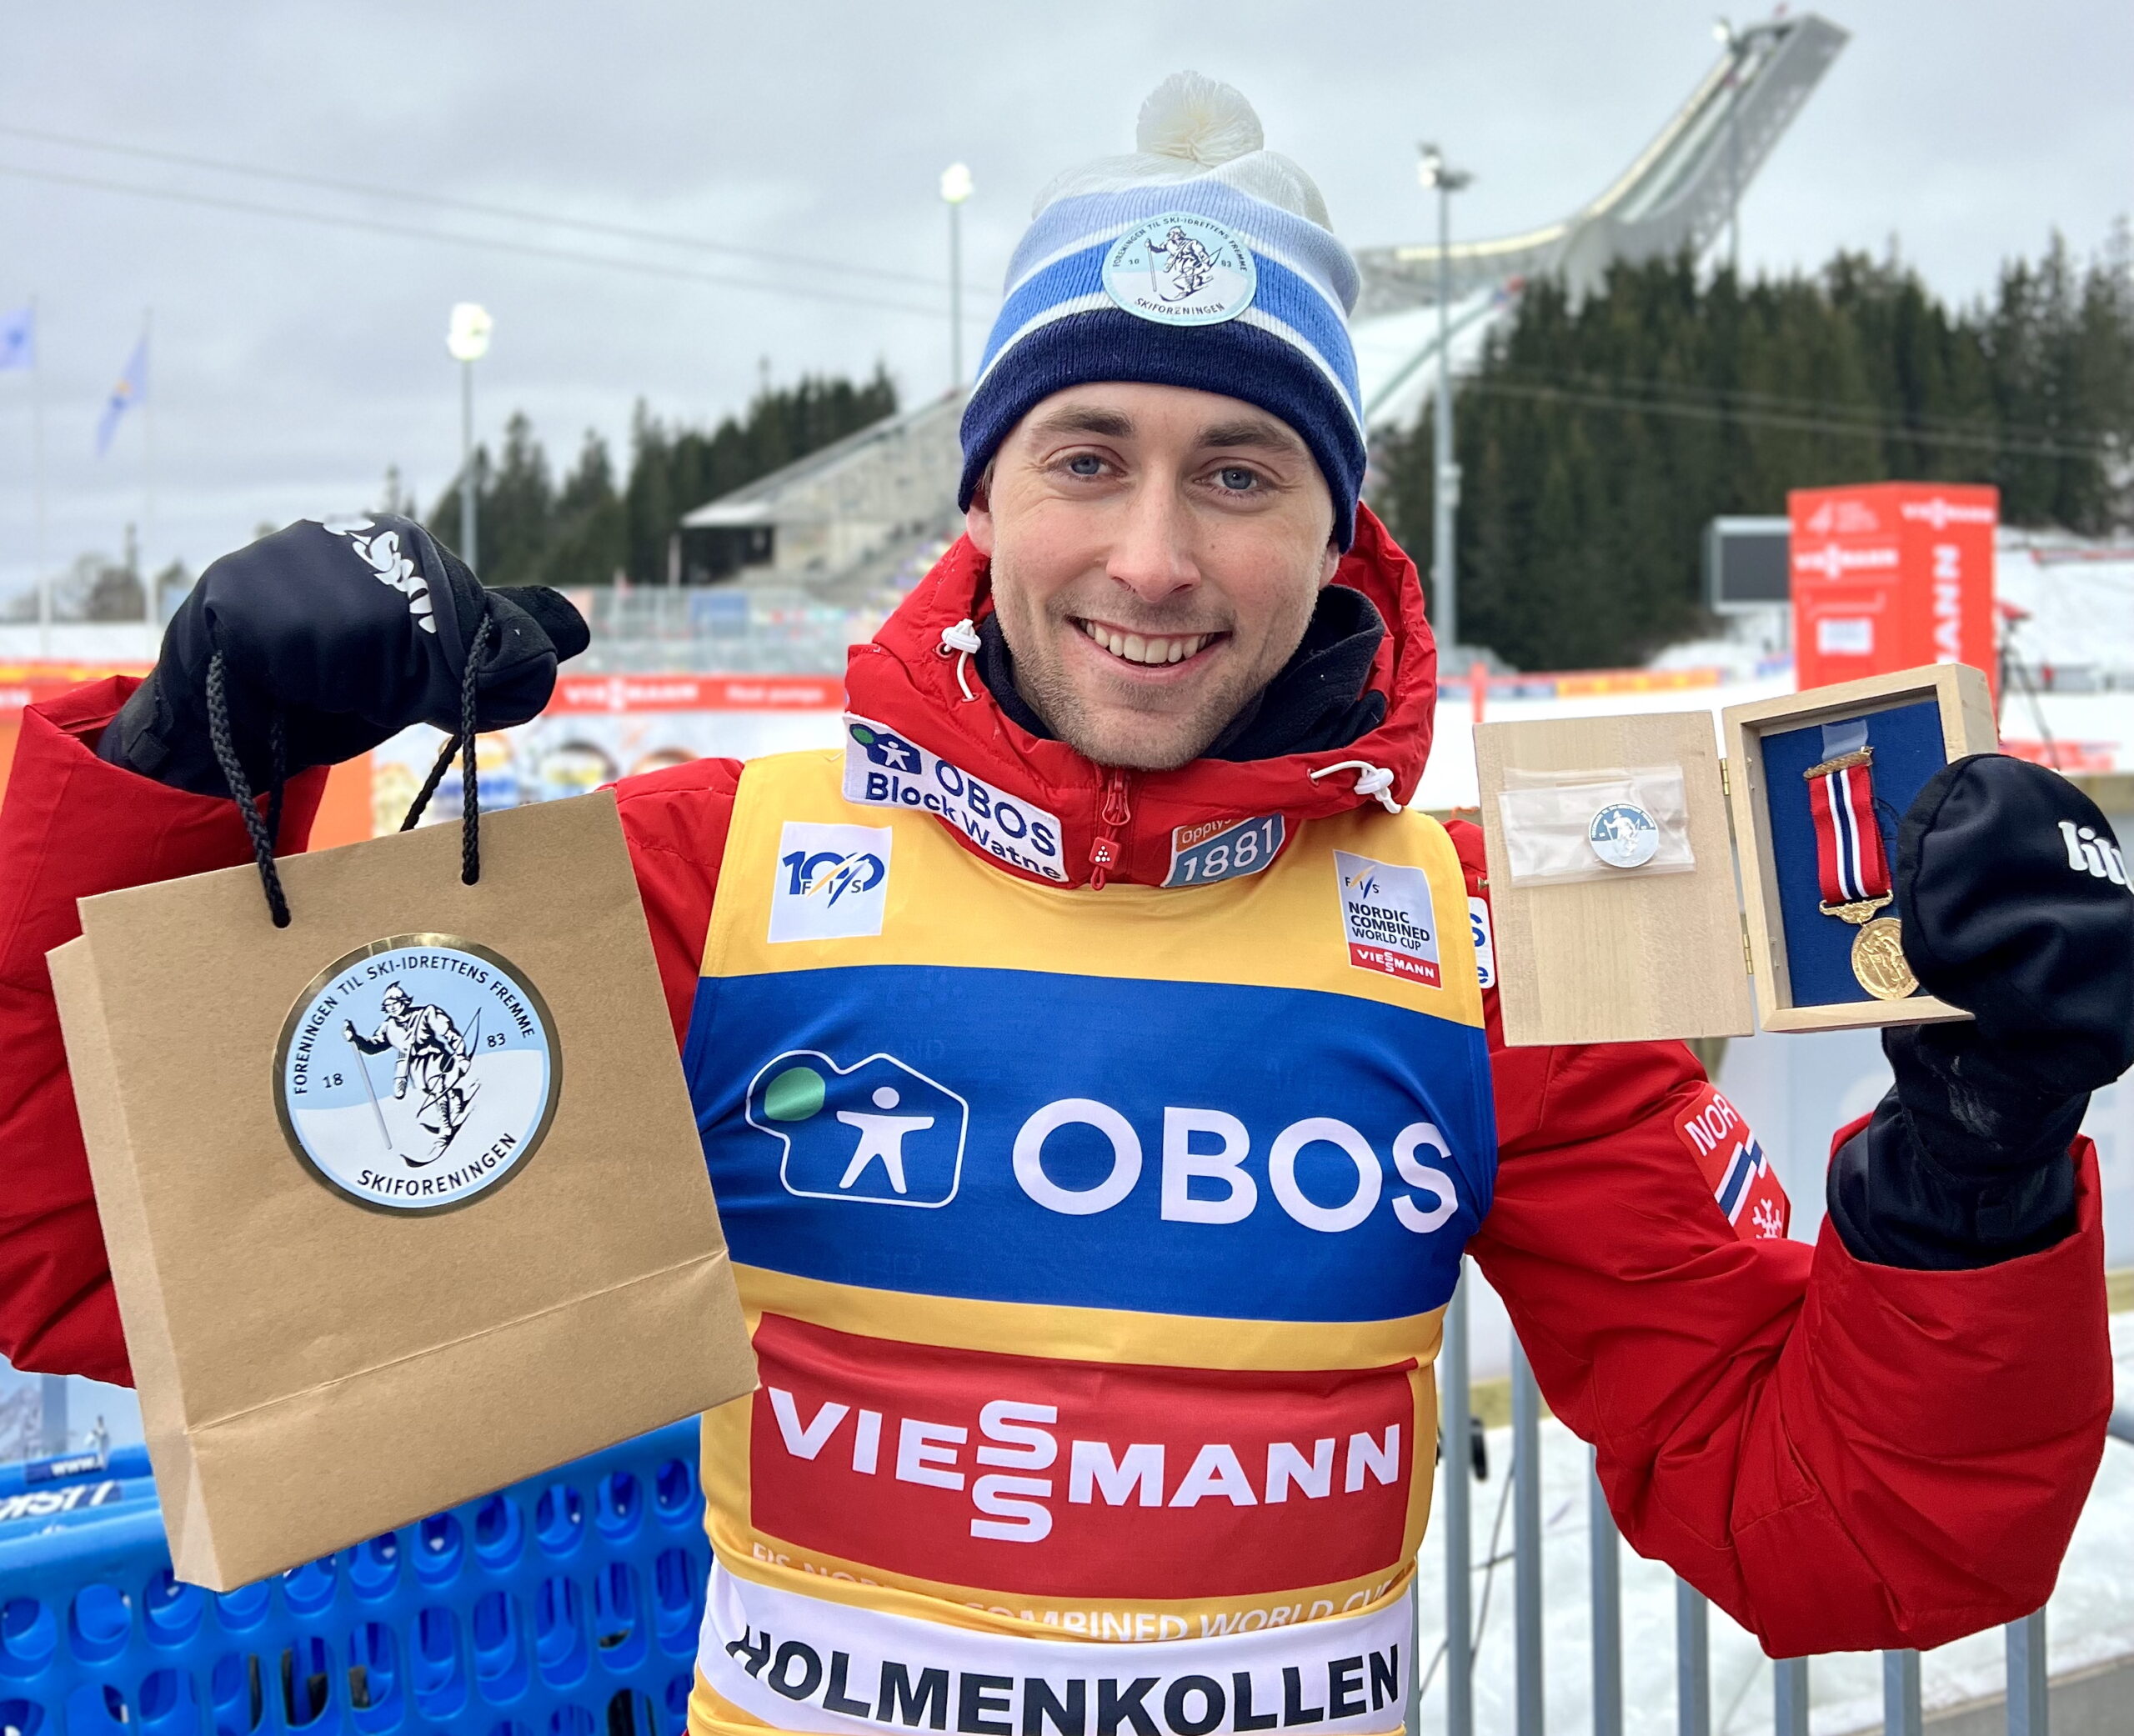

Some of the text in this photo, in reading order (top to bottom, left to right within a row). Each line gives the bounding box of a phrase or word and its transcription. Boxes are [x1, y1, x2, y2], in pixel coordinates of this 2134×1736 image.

[1147, 221, 1161, 231] TIL
[1163, 217, 1230, 239] SKI-IDRETTENS
[1229, 239, 1248, 272] FREMME
[1135, 298, 1225, 315] SKIFORENINGEN
[865, 772, 1062, 879] Block Watne
[934, 759, 1056, 857] OBOS
[1184, 818, 1273, 882] 1881
[802, 879, 862, 895] FIS
[1345, 876, 1380, 894] FIS
[1348, 901, 1410, 923] NORDIC
[1350, 915, 1430, 942] COMBINED
[1351, 927, 1421, 951] WORLD CUP
[1356, 949, 1435, 978] VIESSMANN
[294, 955, 535, 1094] FORENINGEN TIL SKI-IDRETTENS FREMME
[322, 1033, 506, 1088] 18 83
[1684, 1093, 1738, 1157] NOR
[357, 1133, 517, 1196] SKIFORENINGEN
[1012, 1098, 1460, 1234] OBOS
[767, 1385, 1401, 1543] VIESSMANN
[964, 1603, 1189, 1642] BINED
[725, 1623, 1400, 1736] HOLMENKOLLEN
